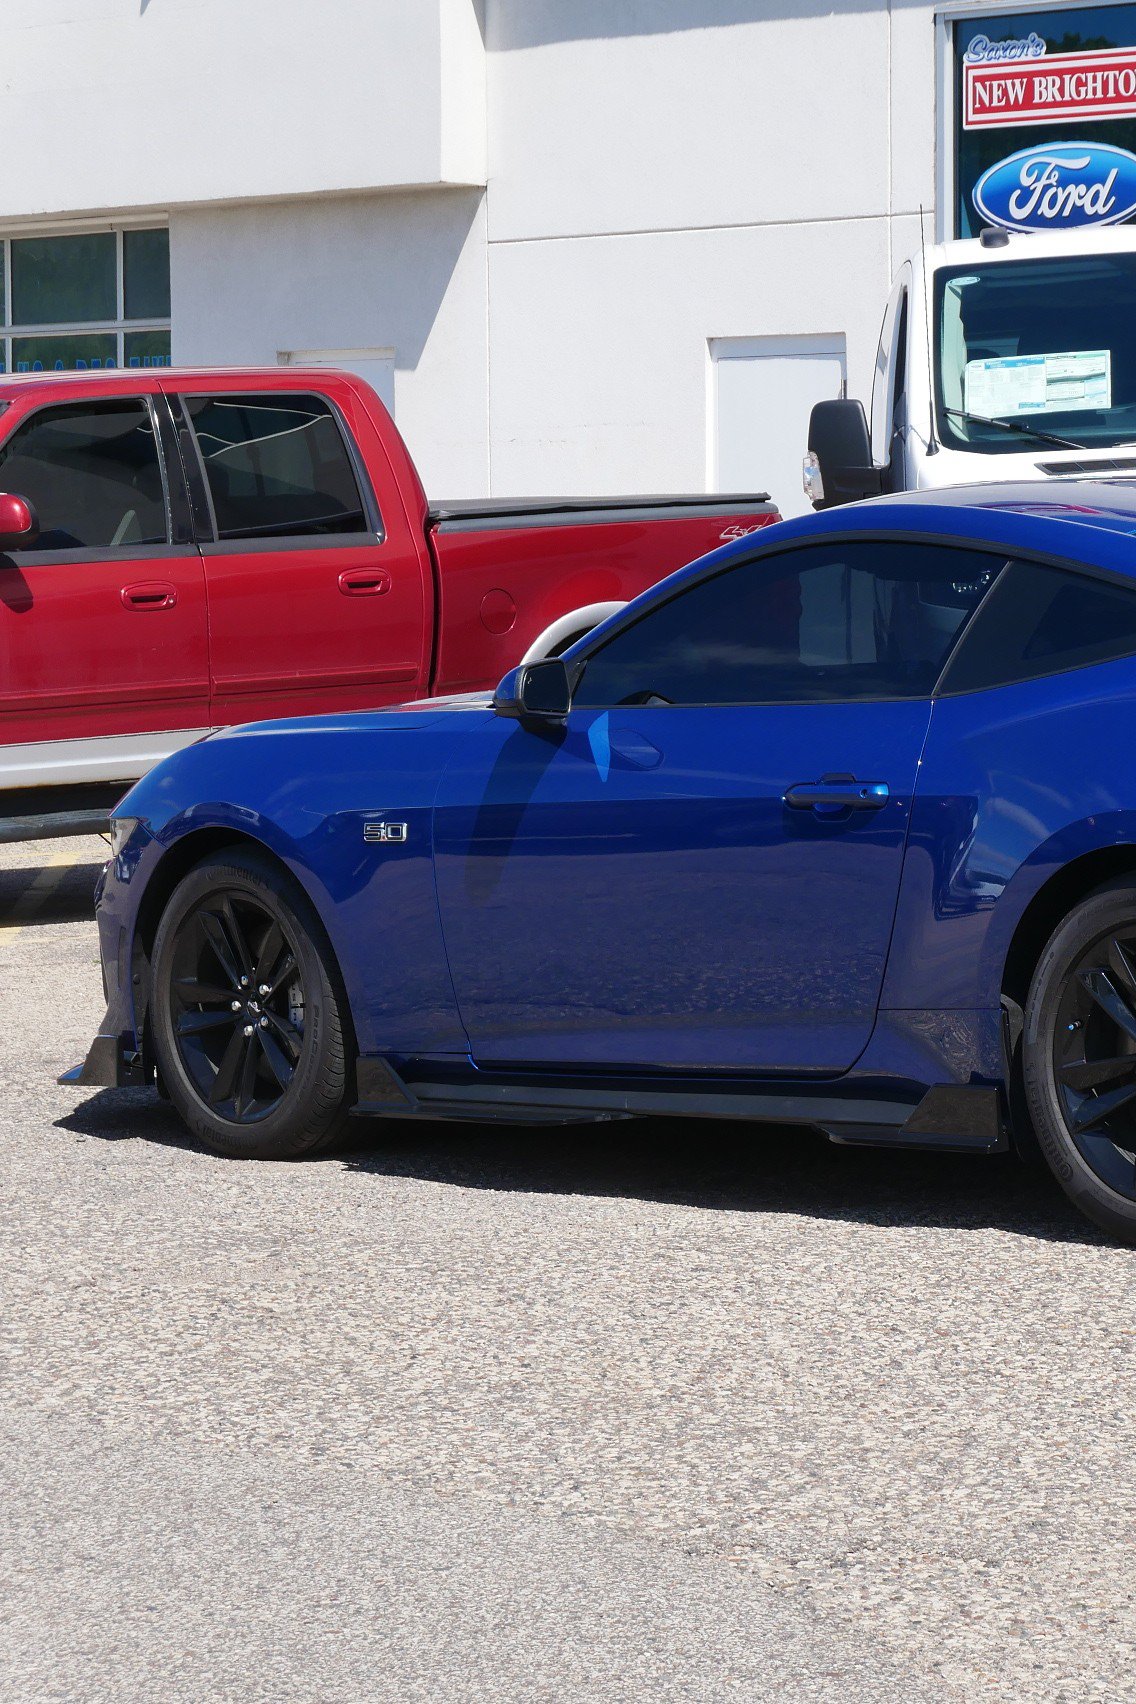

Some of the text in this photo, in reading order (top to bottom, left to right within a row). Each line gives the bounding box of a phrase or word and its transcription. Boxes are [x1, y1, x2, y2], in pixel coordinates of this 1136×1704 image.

[966, 35, 1046, 62] Saxon's
[974, 78, 1027, 108] NEW
[1008, 155, 1119, 220] Ford
